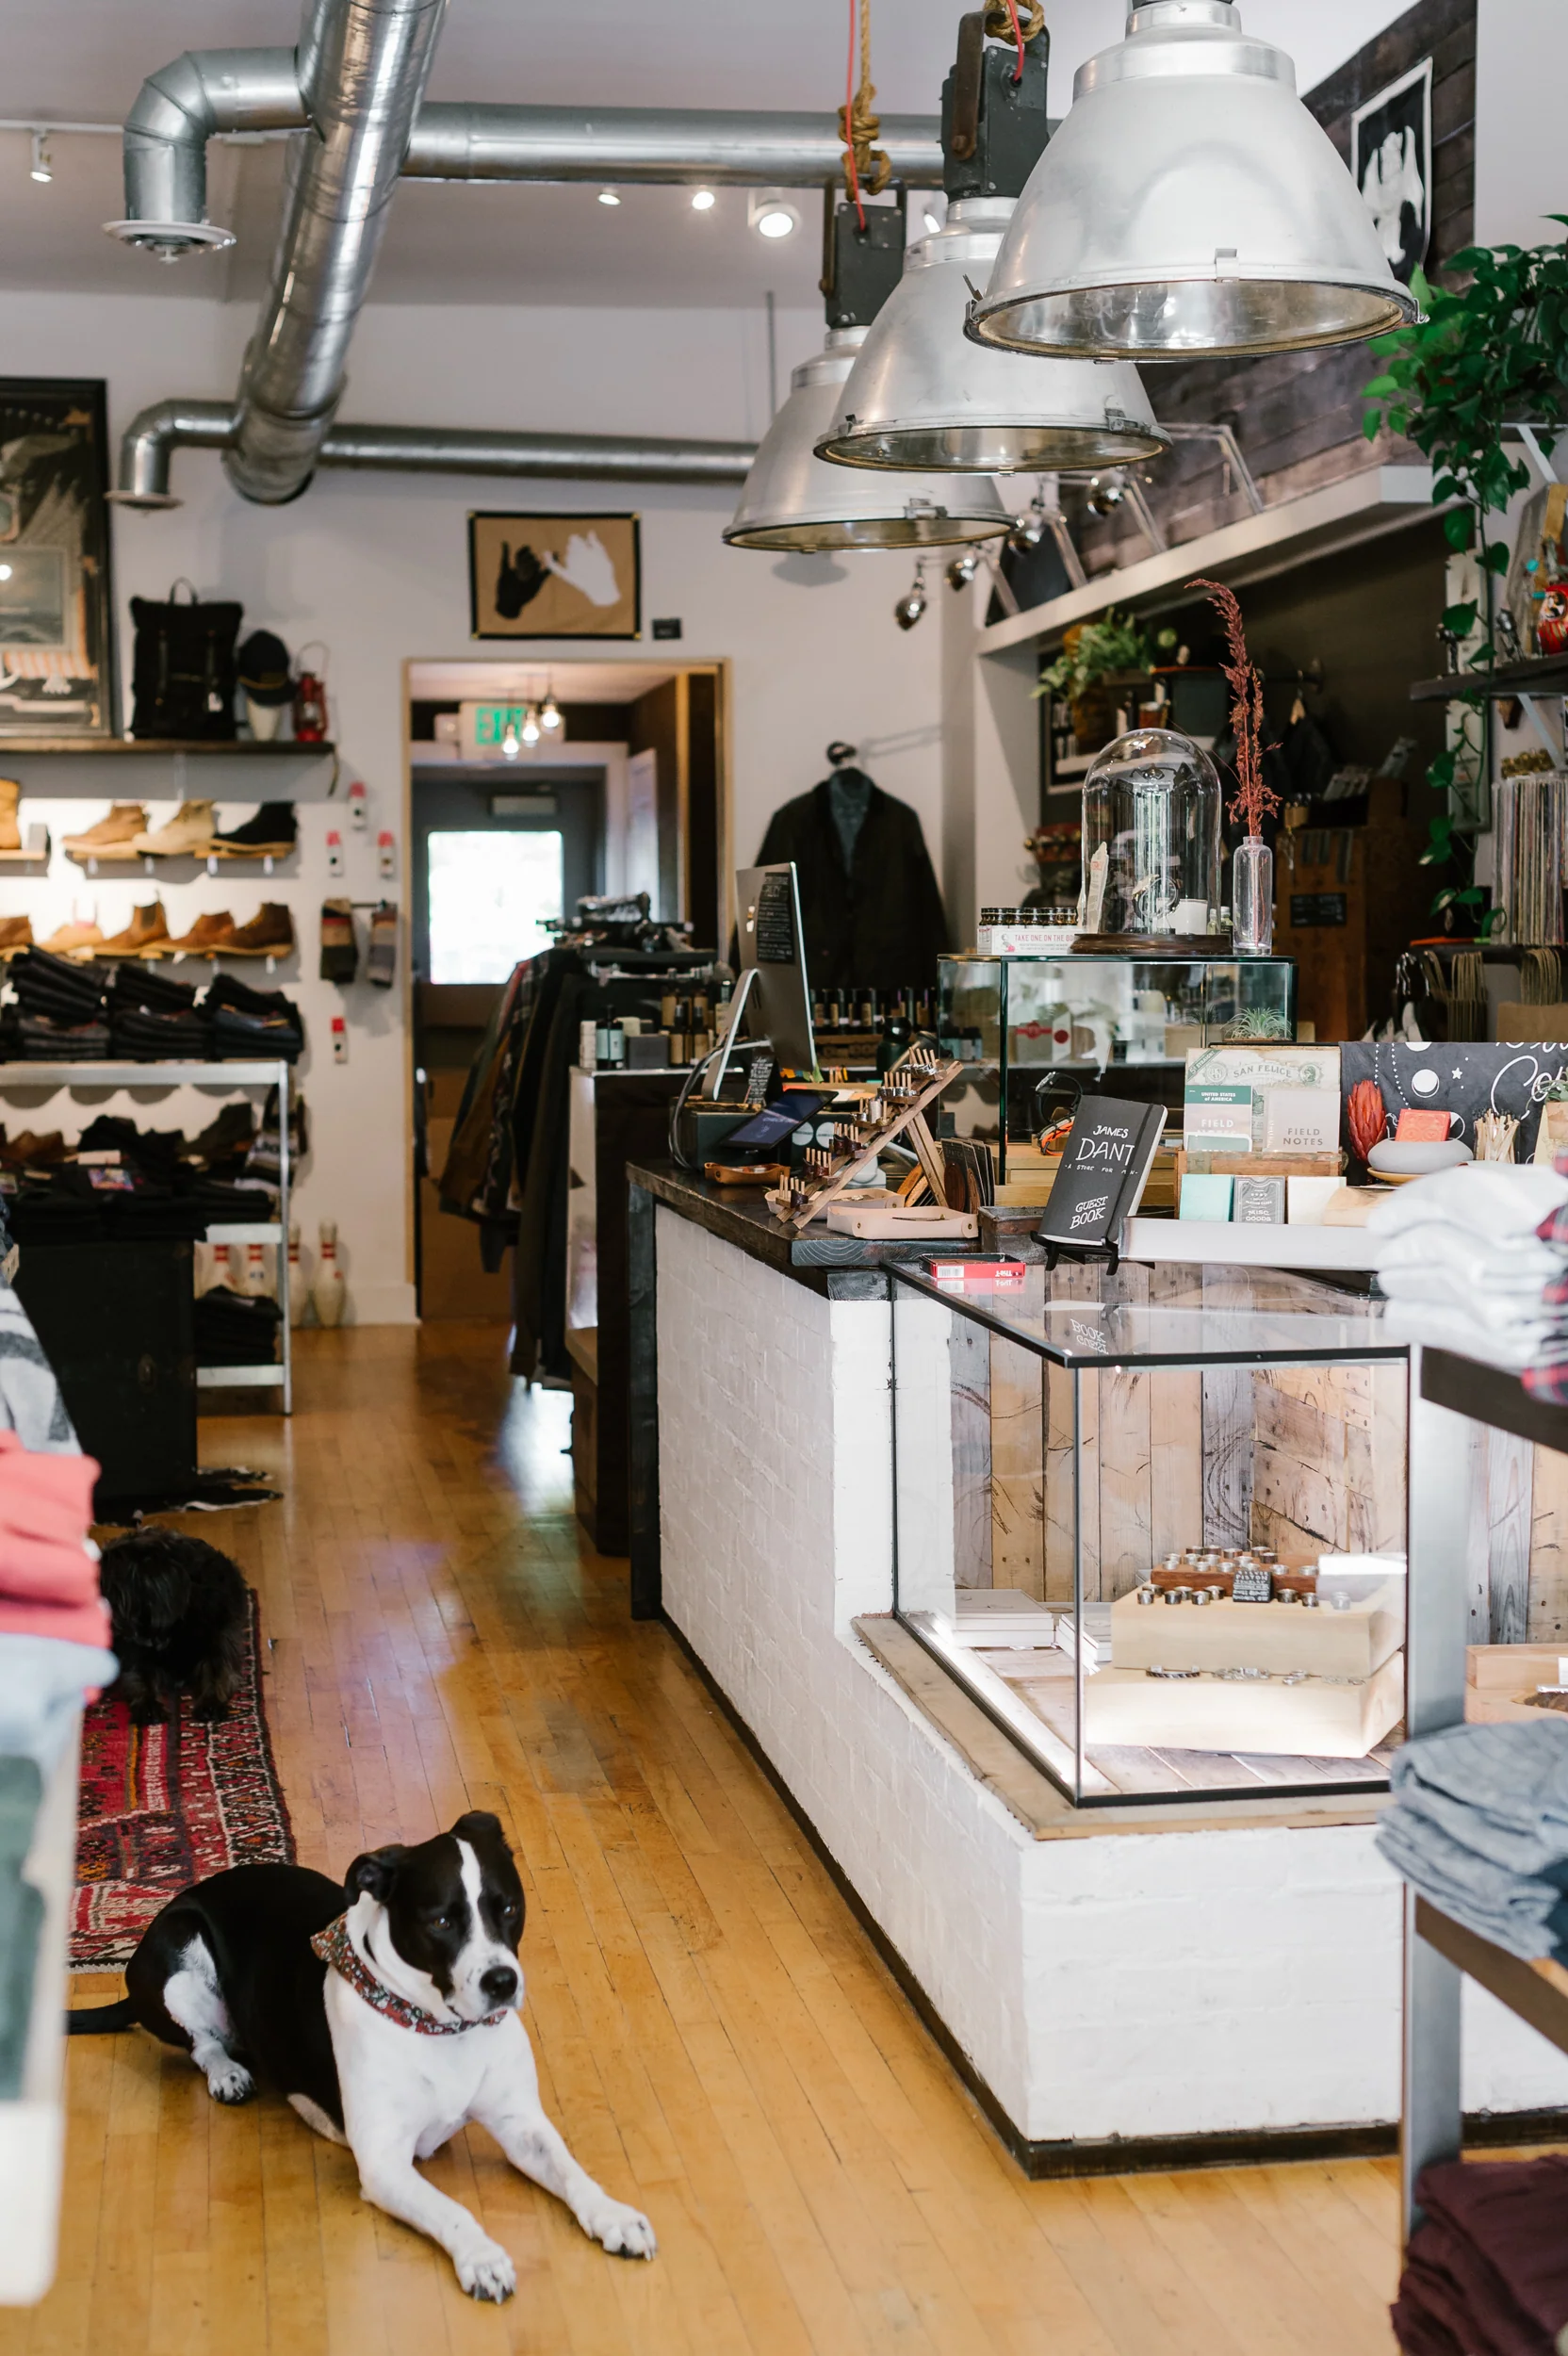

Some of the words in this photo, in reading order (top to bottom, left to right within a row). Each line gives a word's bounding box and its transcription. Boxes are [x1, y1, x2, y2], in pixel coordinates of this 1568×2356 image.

[1233, 1065, 1253, 1078] SAN
[1258, 1064, 1292, 1078] FELICE
[1200, 1119, 1234, 1128] FIELD
[1093, 1125, 1129, 1138] JAMES
[1287, 1127, 1320, 1136] FIELD
[1075, 1137, 1135, 1166] DANT
[1075, 1196, 1109, 1213] GUEST
[1070, 1207, 1106, 1230] BOOK
